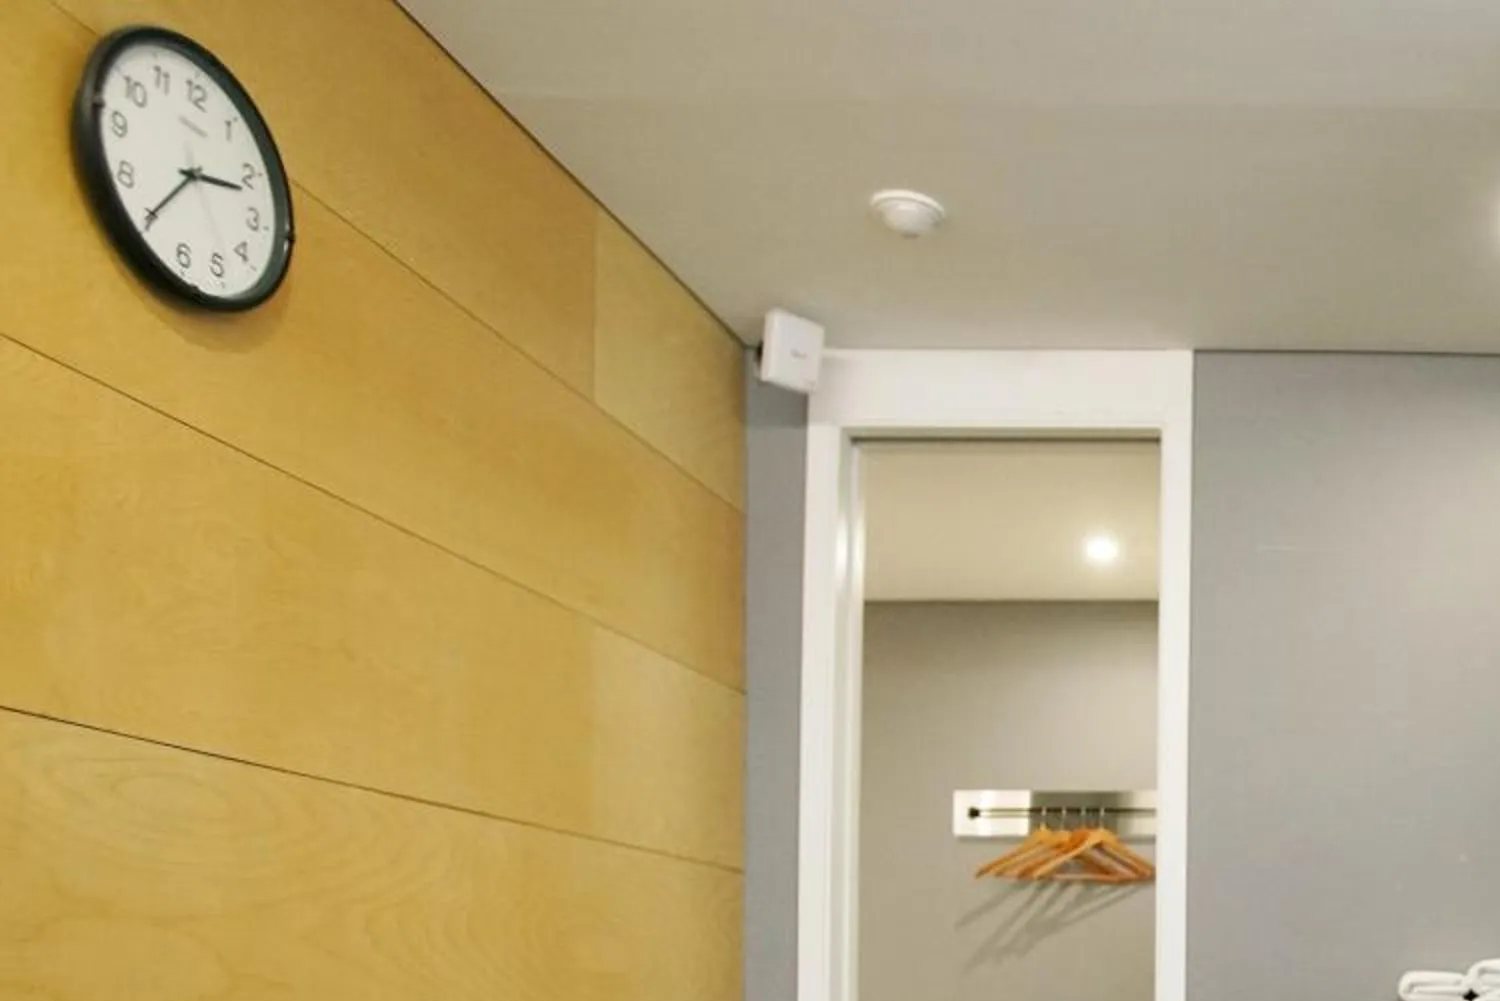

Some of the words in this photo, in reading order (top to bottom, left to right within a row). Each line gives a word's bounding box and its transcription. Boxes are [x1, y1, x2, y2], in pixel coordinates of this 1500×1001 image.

[123, 75, 147, 109] 10
[154, 65, 170, 96] 11
[186, 79, 208, 113] 12
[112, 110, 128, 138] 9
[224, 120, 232, 142] 1
[117, 160, 135, 189] 8
[241, 162, 255, 189] 2
[246, 206, 259, 232] 3
[176, 242, 191, 268] 6
[210, 251, 224, 278] 5
[233, 241, 248, 263] 4
